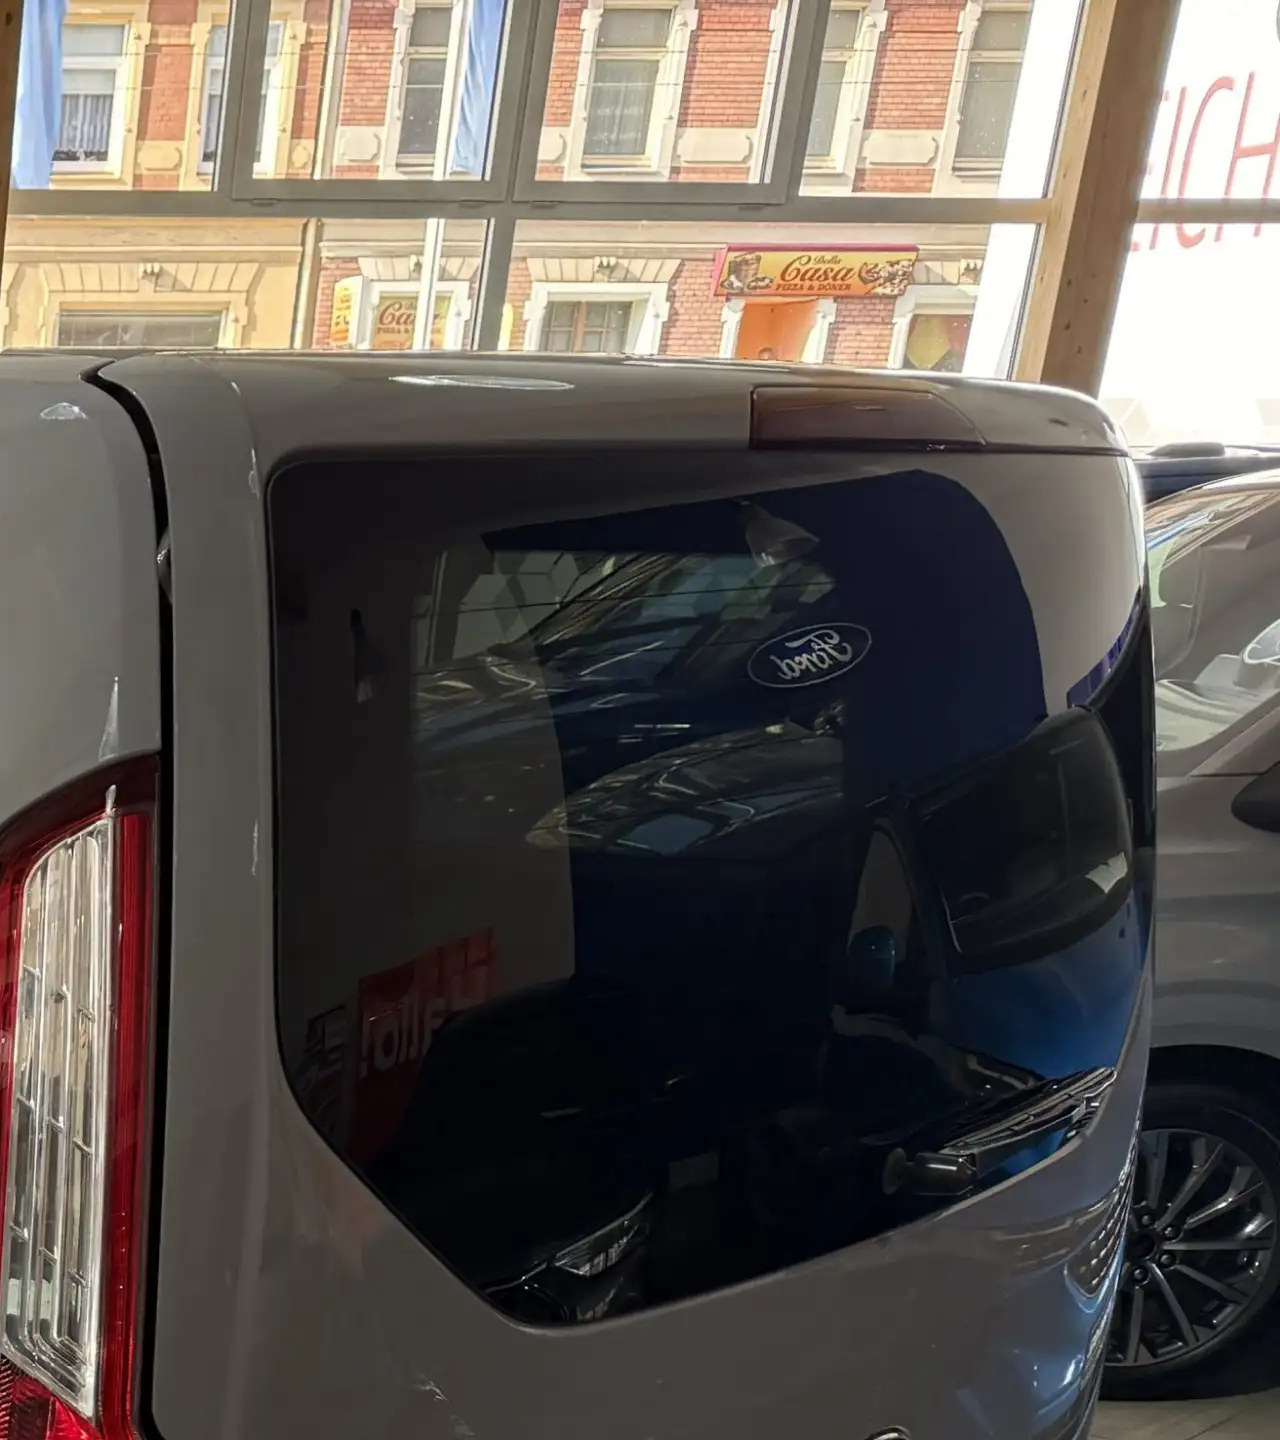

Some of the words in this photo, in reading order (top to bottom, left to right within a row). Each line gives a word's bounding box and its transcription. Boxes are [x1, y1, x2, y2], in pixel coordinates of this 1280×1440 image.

[779, 254, 855, 283] Casa
[776, 283, 805, 292] PIZZA
[816, 281, 853, 292] DÖNER
